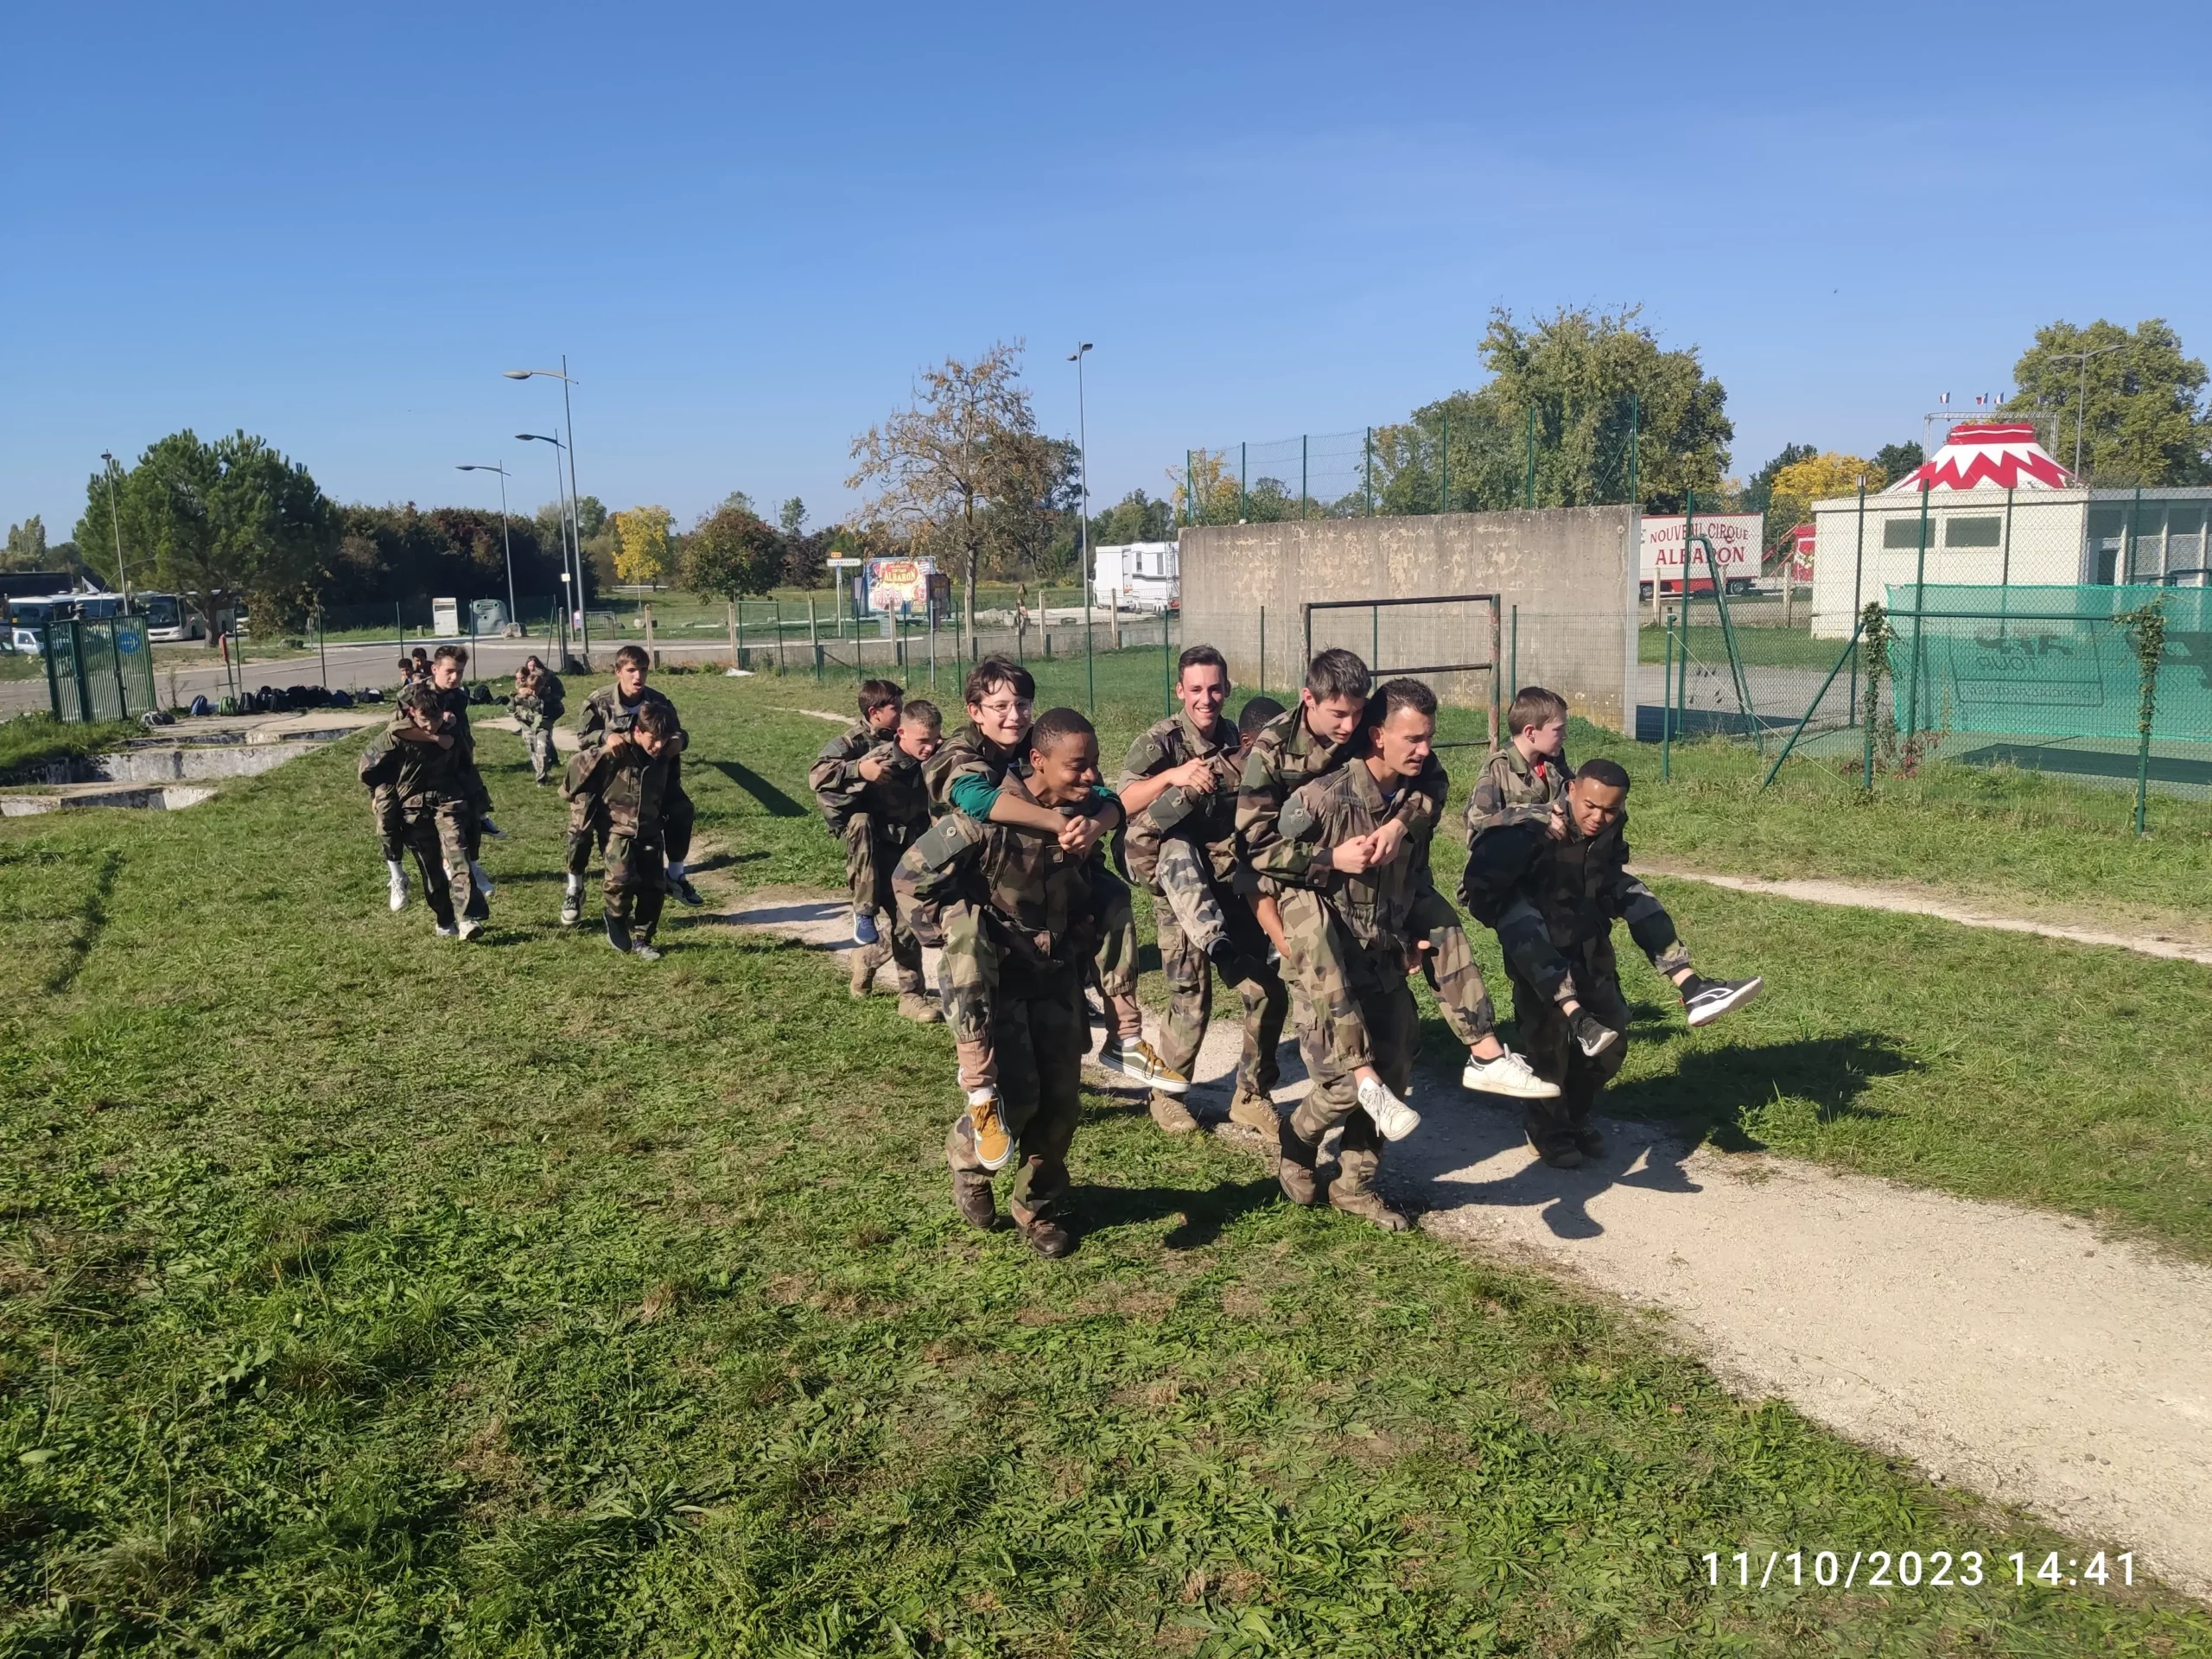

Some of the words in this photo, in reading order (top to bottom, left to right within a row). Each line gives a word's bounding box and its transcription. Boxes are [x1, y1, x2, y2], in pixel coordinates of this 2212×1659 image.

[1649, 524, 1702, 543] NOUVEAU
[1708, 523, 1749, 543] CIRQUE
[884, 569, 916, 582] ALBARON
